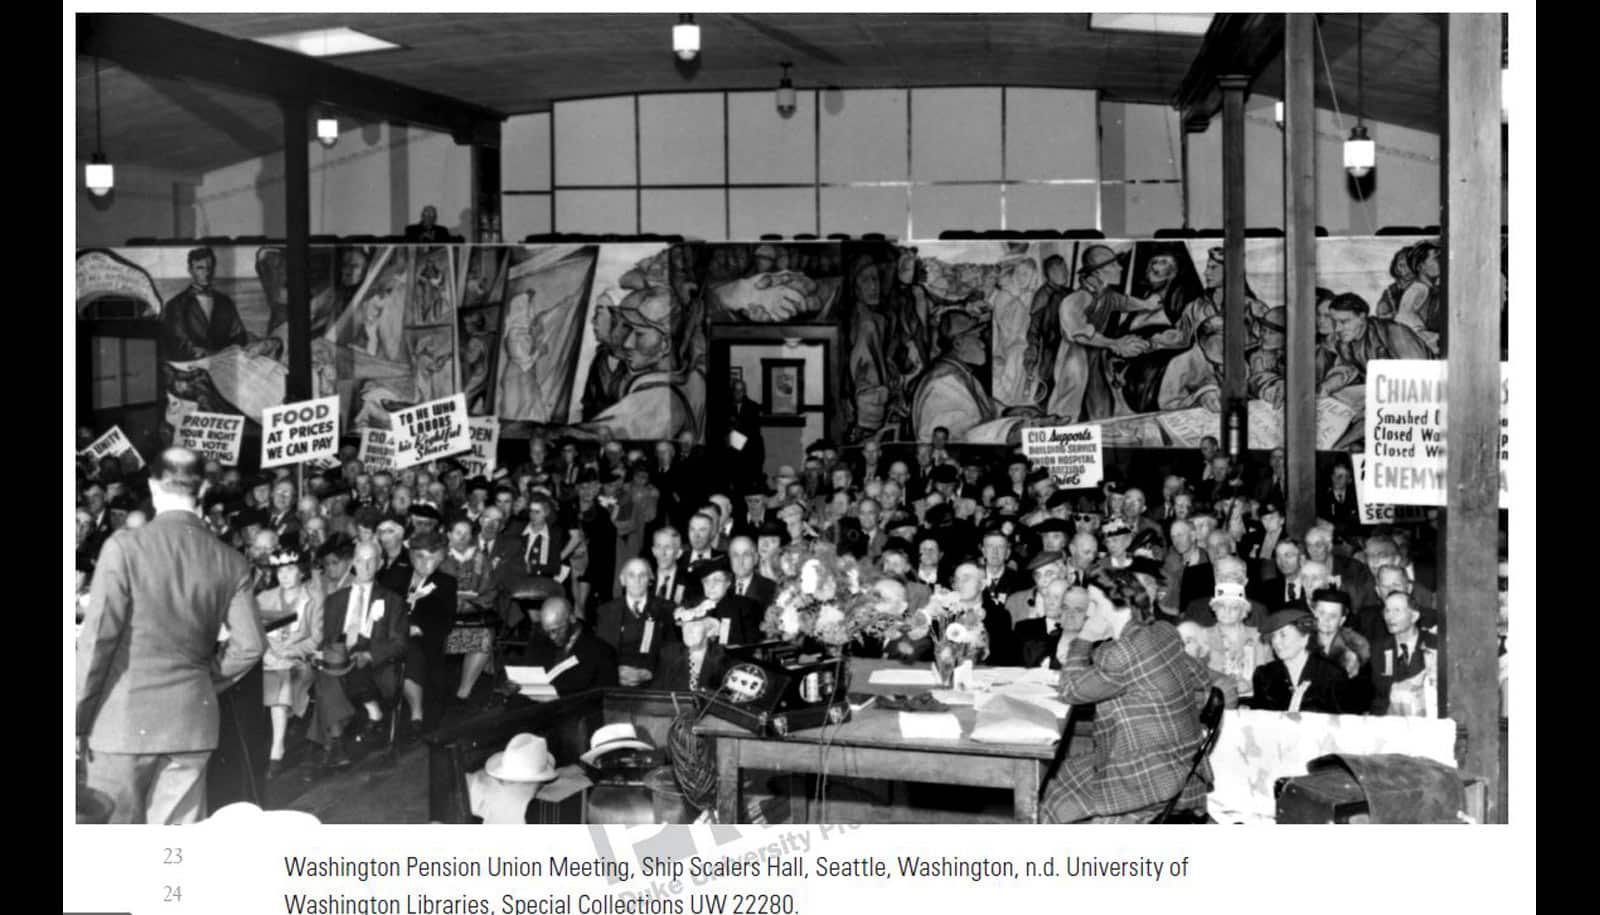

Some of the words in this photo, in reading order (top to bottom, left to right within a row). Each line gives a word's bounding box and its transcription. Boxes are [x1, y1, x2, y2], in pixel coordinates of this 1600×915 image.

[181, 414, 241, 431] PROTECT
[271, 404, 329, 428] FOOD
[398, 412, 413, 426] TO
[416, 406, 429, 421] HE
[431, 400, 455, 416] WHO
[1376, 408, 1428, 426] Smashed
[179, 428, 204, 439] YOUR
[206, 430, 236, 442] RIGHT
[267, 430, 283, 444] AT
[289, 420, 334, 440] PRICES
[409, 415, 451, 438] LABORS
[1373, 426, 1414, 443] Closed
[183, 438, 198, 449] TO
[201, 440, 229, 451] VOTE
[1028, 430, 1047, 444] CIO
[1050, 427, 1092, 447] Supports
[266, 446, 282, 461] WE
[286, 441, 308, 457] CAN
[312, 436, 334, 452] PAY
[1375, 442, 1416, 458] Closed
